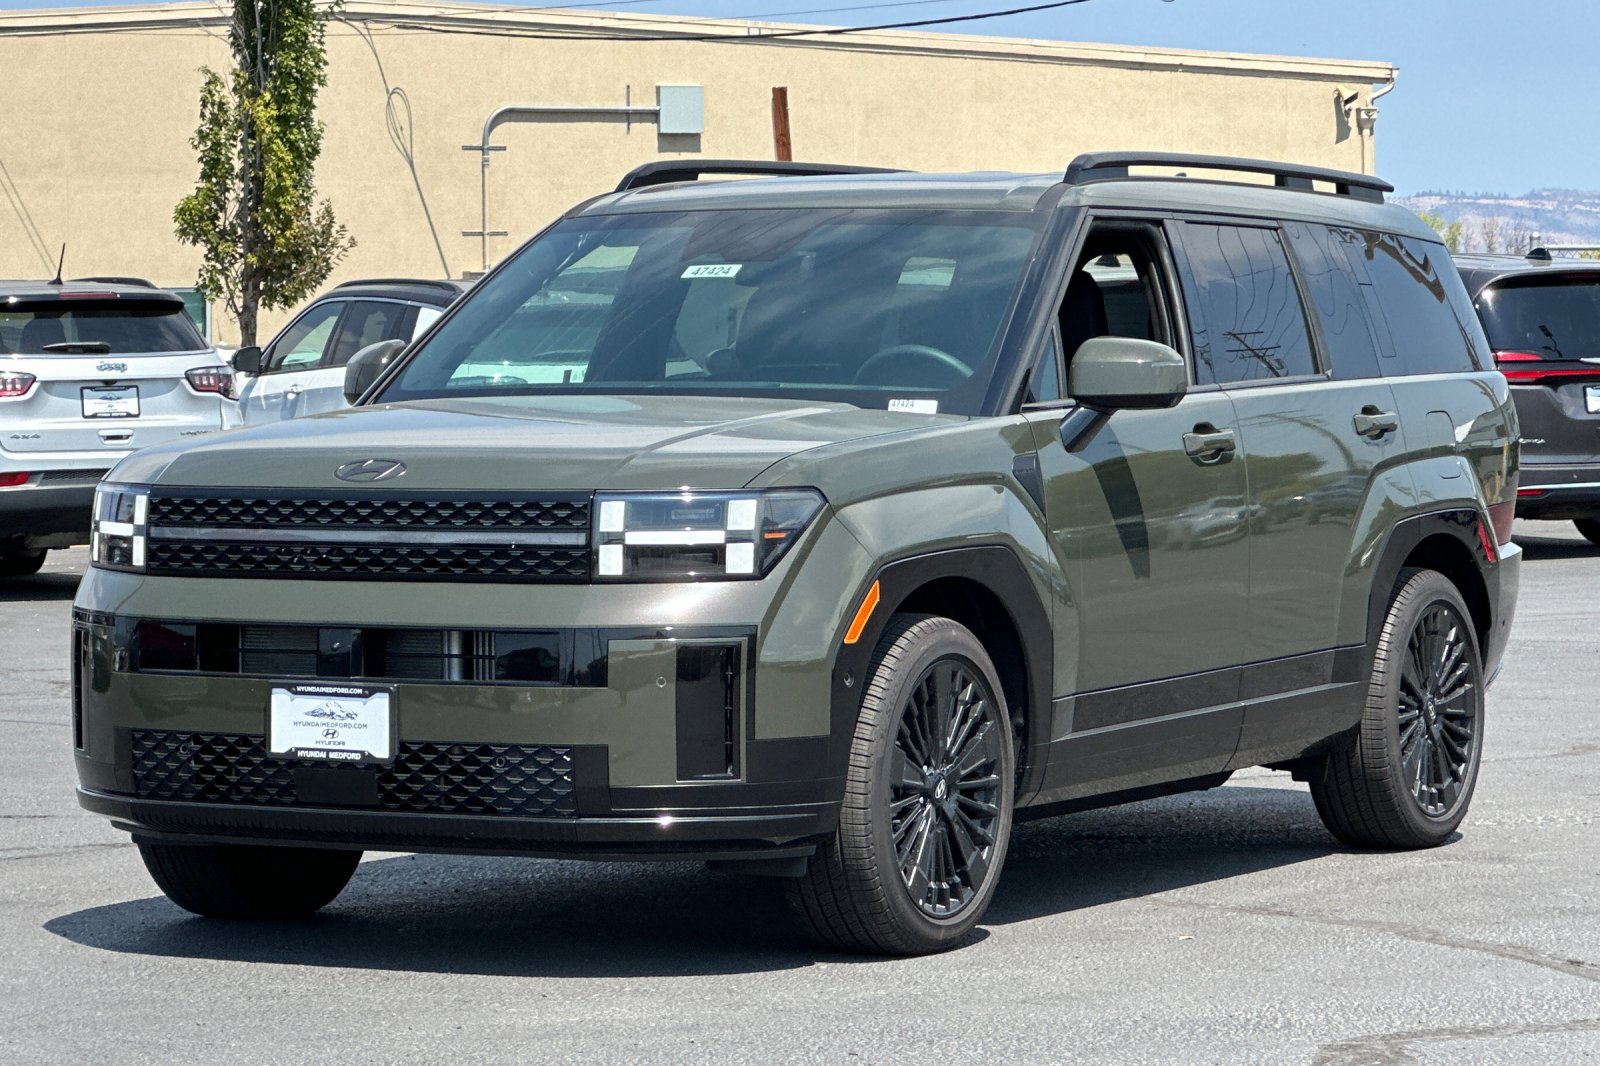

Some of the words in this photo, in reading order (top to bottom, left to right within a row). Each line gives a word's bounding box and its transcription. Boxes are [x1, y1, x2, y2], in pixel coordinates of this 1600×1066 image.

[691, 266, 732, 276] 47424
[96, 361, 128, 373] Jeep
[891, 400, 914, 408] 47424
[296, 685, 363, 695] HYUNDAIMEDFORD.COM
[293, 721, 368, 729] HYUNDAIMEDFORD.COM
[297, 750, 327, 759] HYUNDAI
[328, 751, 361, 760] MEDFORD
